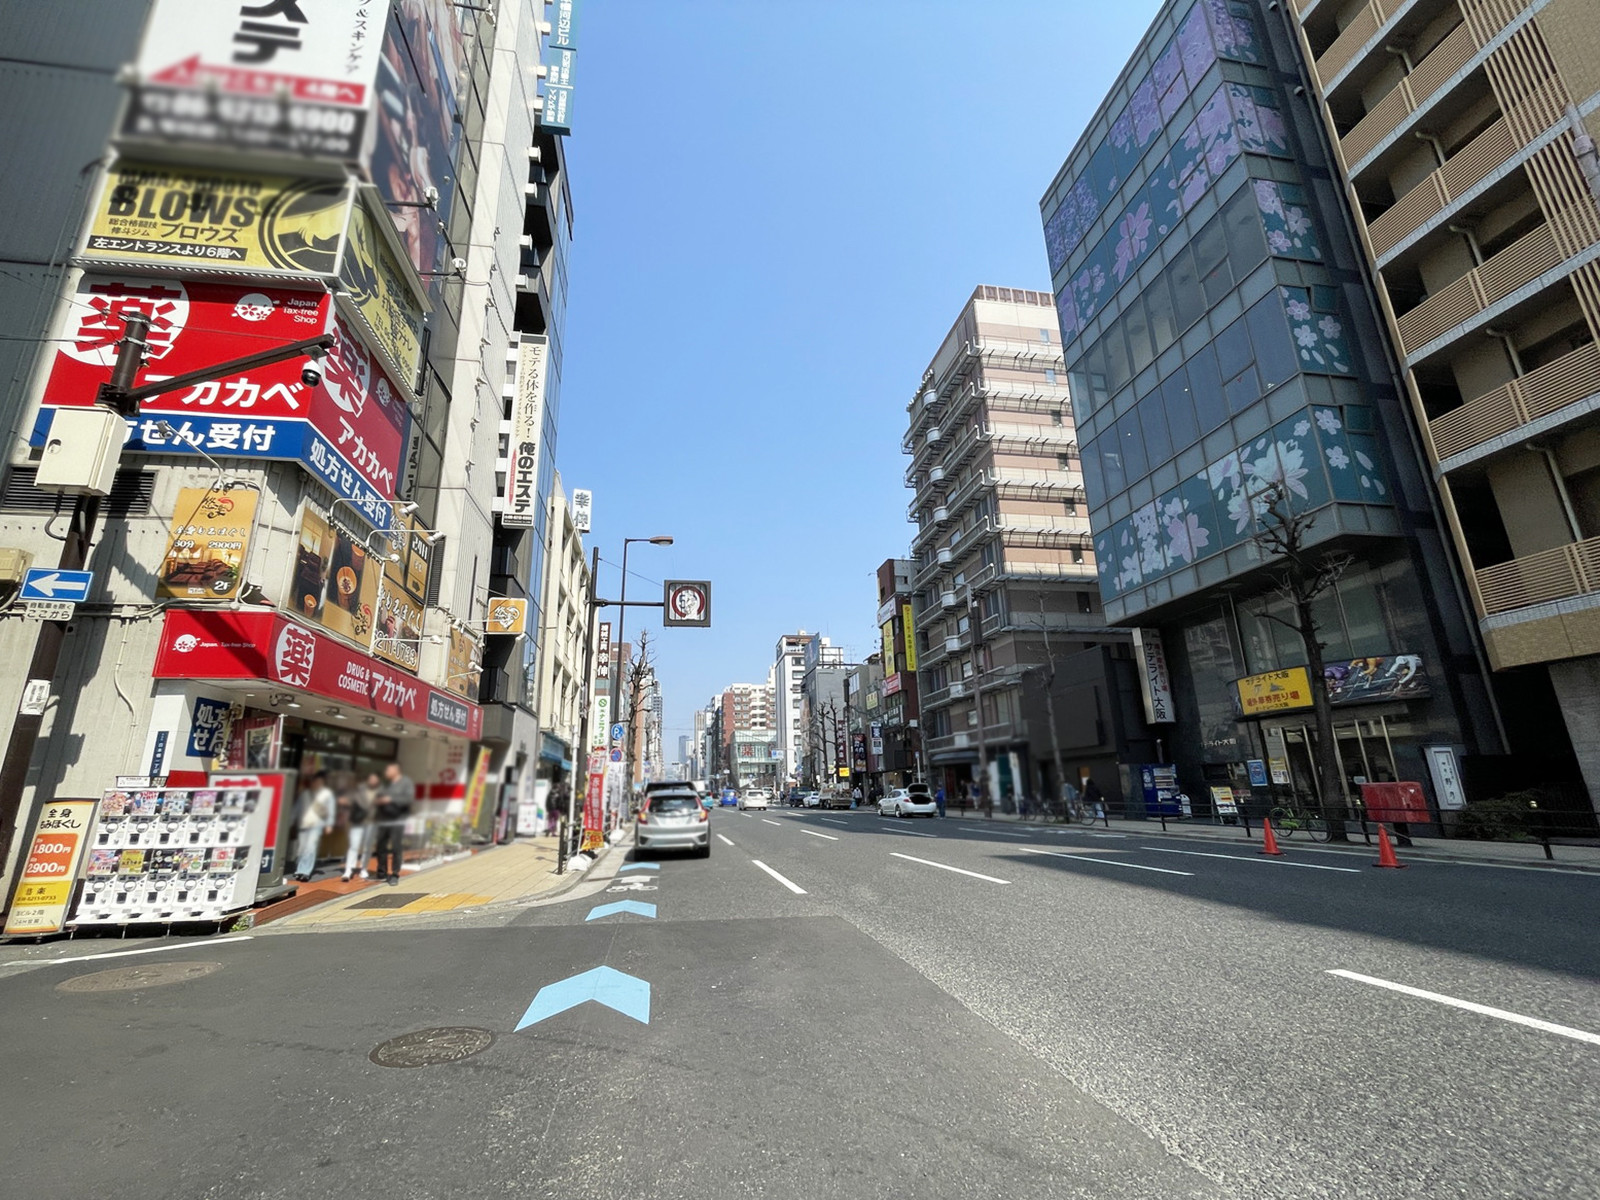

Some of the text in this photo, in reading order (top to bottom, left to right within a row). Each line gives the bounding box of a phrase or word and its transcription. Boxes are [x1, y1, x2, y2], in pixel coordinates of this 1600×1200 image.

[108, 184, 260, 228] BLOWS
[160, 221, 243, 243] ブロウズ
[93, 237, 242, 259] 左エントランスより6階へ
[287, 297, 320, 308] Japan.
[293, 314, 318, 325] Shop
[338, 415, 393, 495] アカカベ
[309, 437, 388, 528] 処方せん受付
[514, 441, 536, 514] 俺のエステ
[27, 609, 70, 620] ここから
[346, 661, 371, 681] DRUG &
[1145, 642, 1167, 720] サテライト大阪
[337, 674, 369, 696] COSMETIC
[370, 671, 417, 711] アカカベ
[40, 819, 82, 830] もみほぐし
[48, 808, 73, 819] 全身
